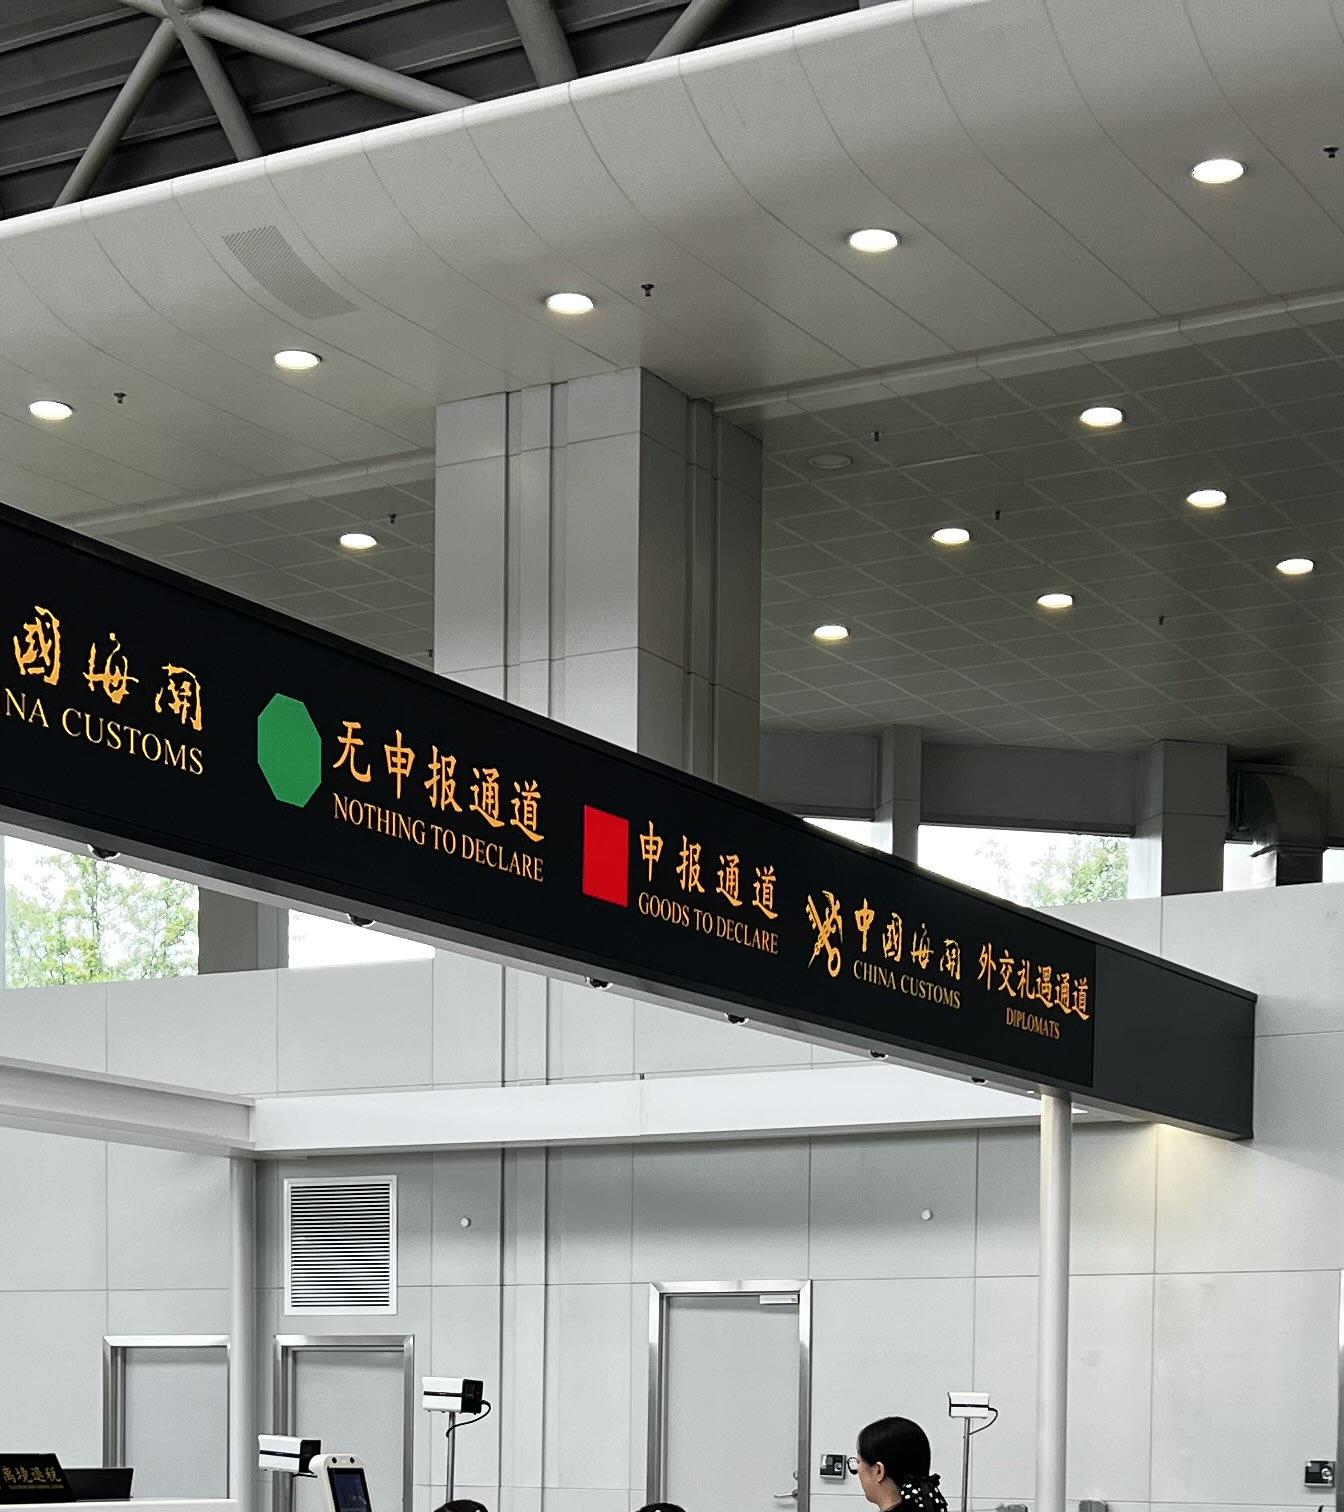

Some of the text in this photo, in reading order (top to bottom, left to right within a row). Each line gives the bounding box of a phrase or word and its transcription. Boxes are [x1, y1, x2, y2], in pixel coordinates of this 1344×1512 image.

[62, 708, 204, 776] CUSTOMS
[333, 720, 545, 843] 无申报通道
[333, 793, 544, 883] NOTHING TO DECLARE
[639, 820, 779, 920] 申报通道
[638, 891, 779, 955] GOODS TO DECLARE
[852, 959, 961, 1009] CHINA CUSTOMS
[977, 942, 1090, 1021] 外交礼遇通道
[1006, 1006, 1061, 1040] DIPLOMATS
